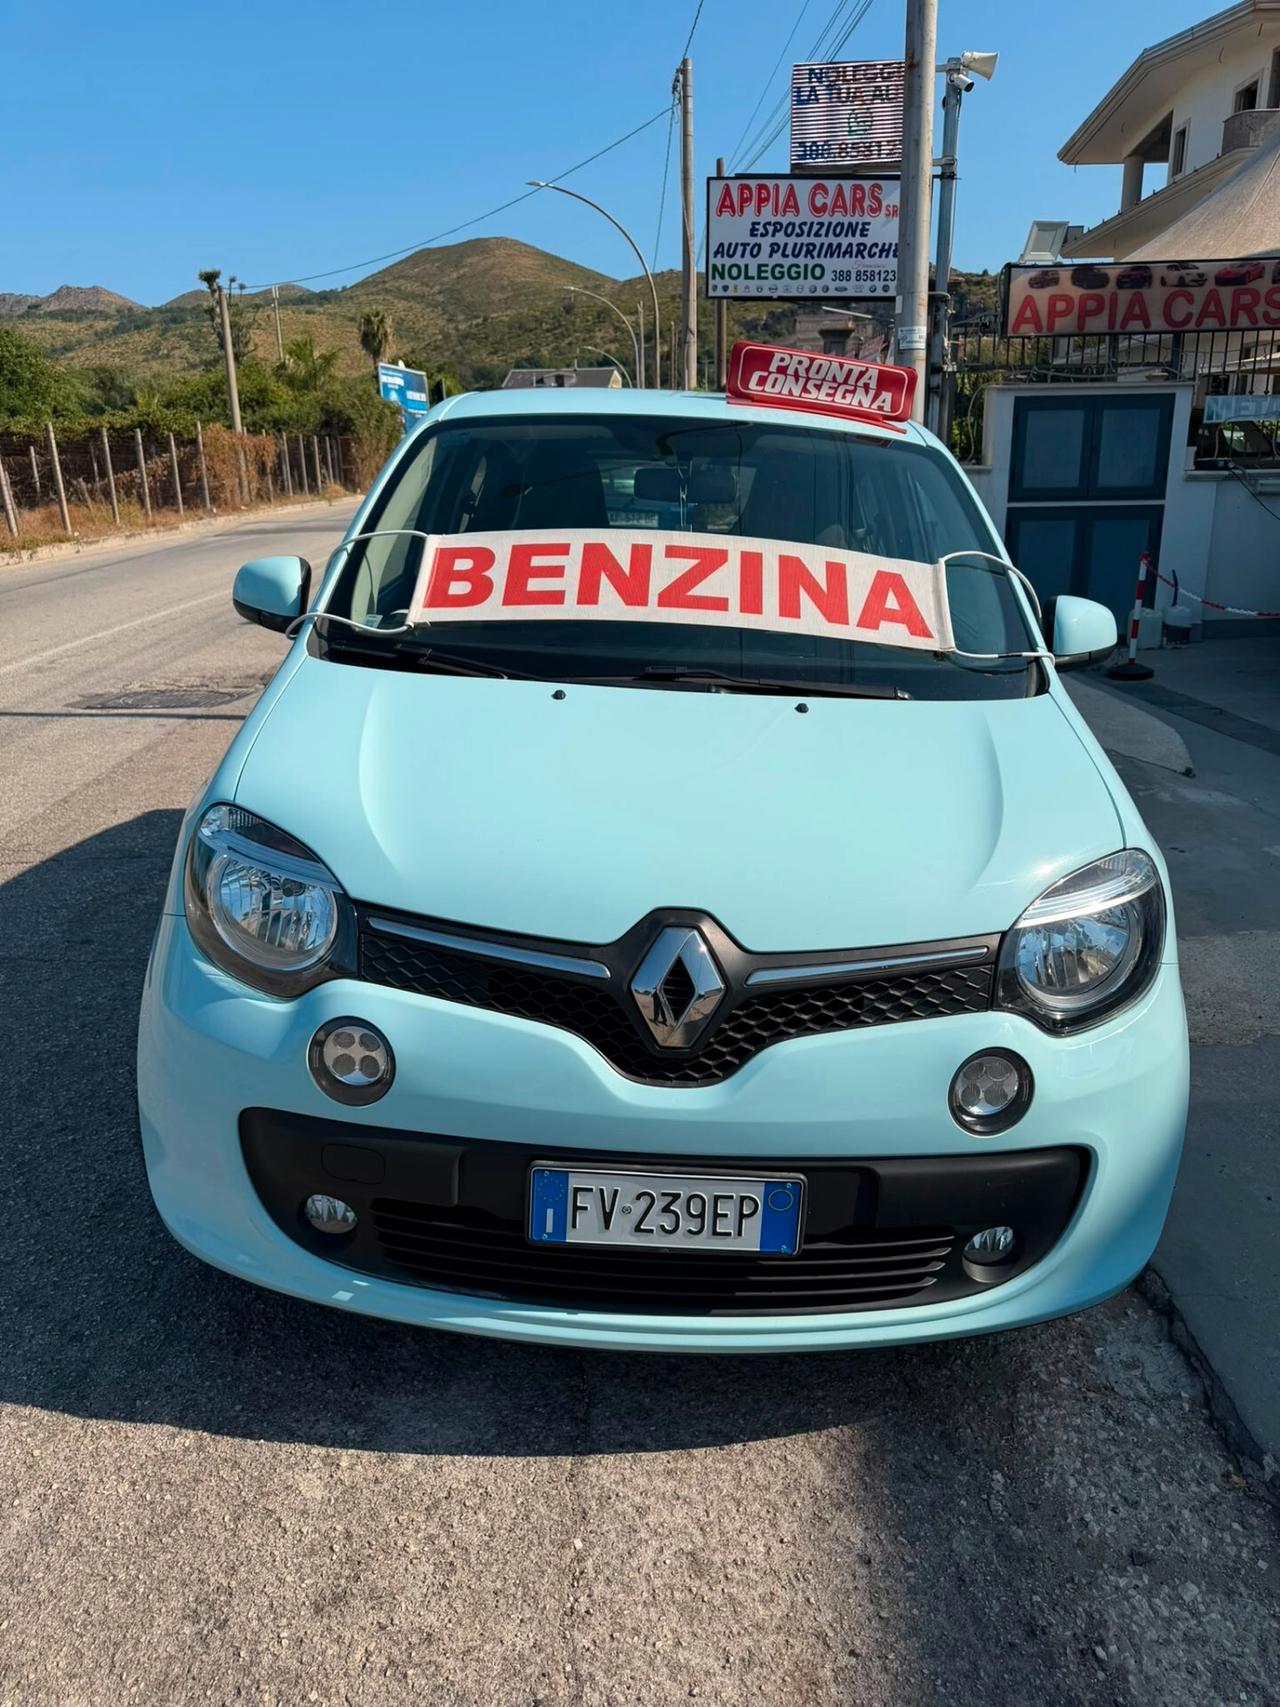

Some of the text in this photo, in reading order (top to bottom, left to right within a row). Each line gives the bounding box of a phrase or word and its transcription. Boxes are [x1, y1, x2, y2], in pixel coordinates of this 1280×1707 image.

[716, 183, 800, 217] APPIA
[808, 182, 883, 217] CARS
[750, 221, 871, 238] ESPOSIZIONE
[713, 242, 762, 259] AUTO
[711, 263, 825, 281] NOLEGGIO
[831, 270, 851, 282] 388
[1011, 287, 1280, 333] APPIA CARS
[769, 352, 879, 390] PRONTA
[748, 371, 893, 412] CONSEGNA
[422, 542, 935, 639] BENZINA
